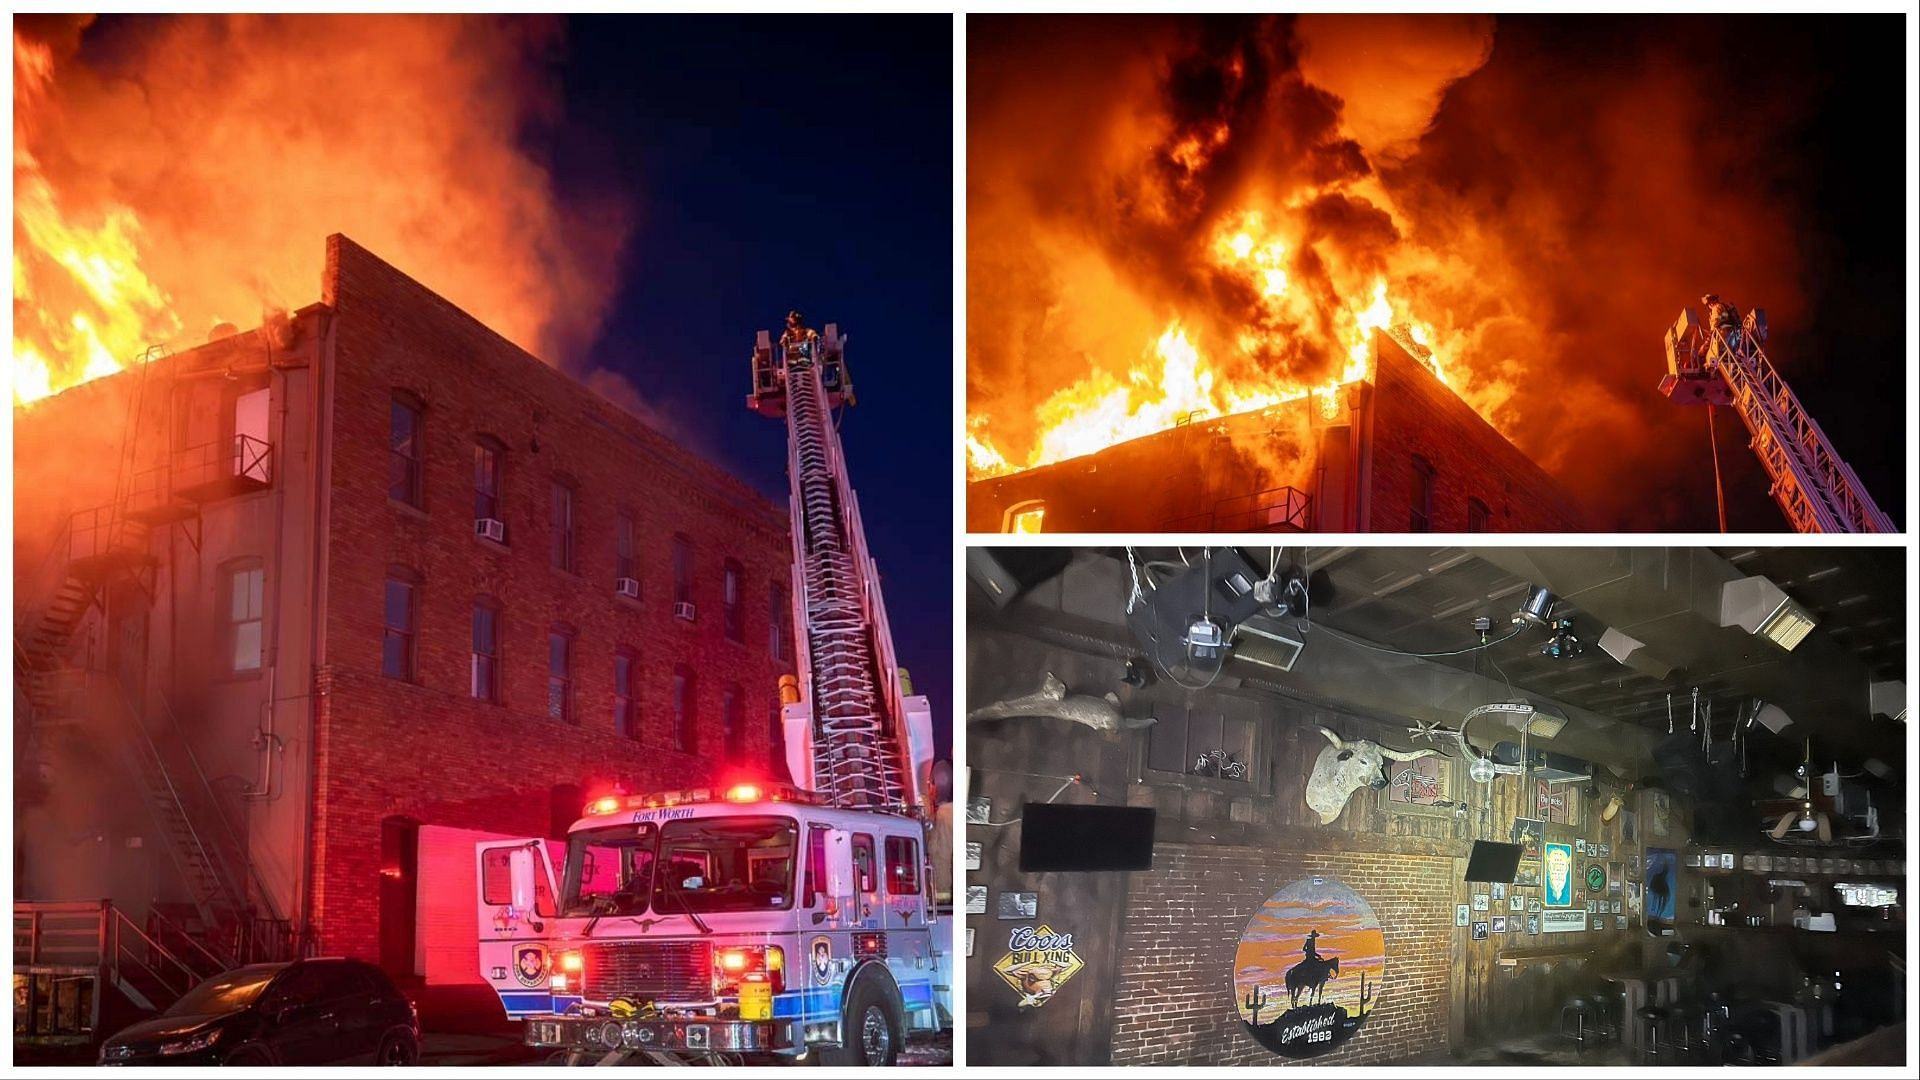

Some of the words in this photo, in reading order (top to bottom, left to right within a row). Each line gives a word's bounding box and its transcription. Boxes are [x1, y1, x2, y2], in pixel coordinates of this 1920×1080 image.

[658, 807, 695, 819] WORTH
[1009, 926, 1074, 951] Coors
[1043, 951, 1070, 963] XING
[1281, 1012, 1335, 1044] Established
